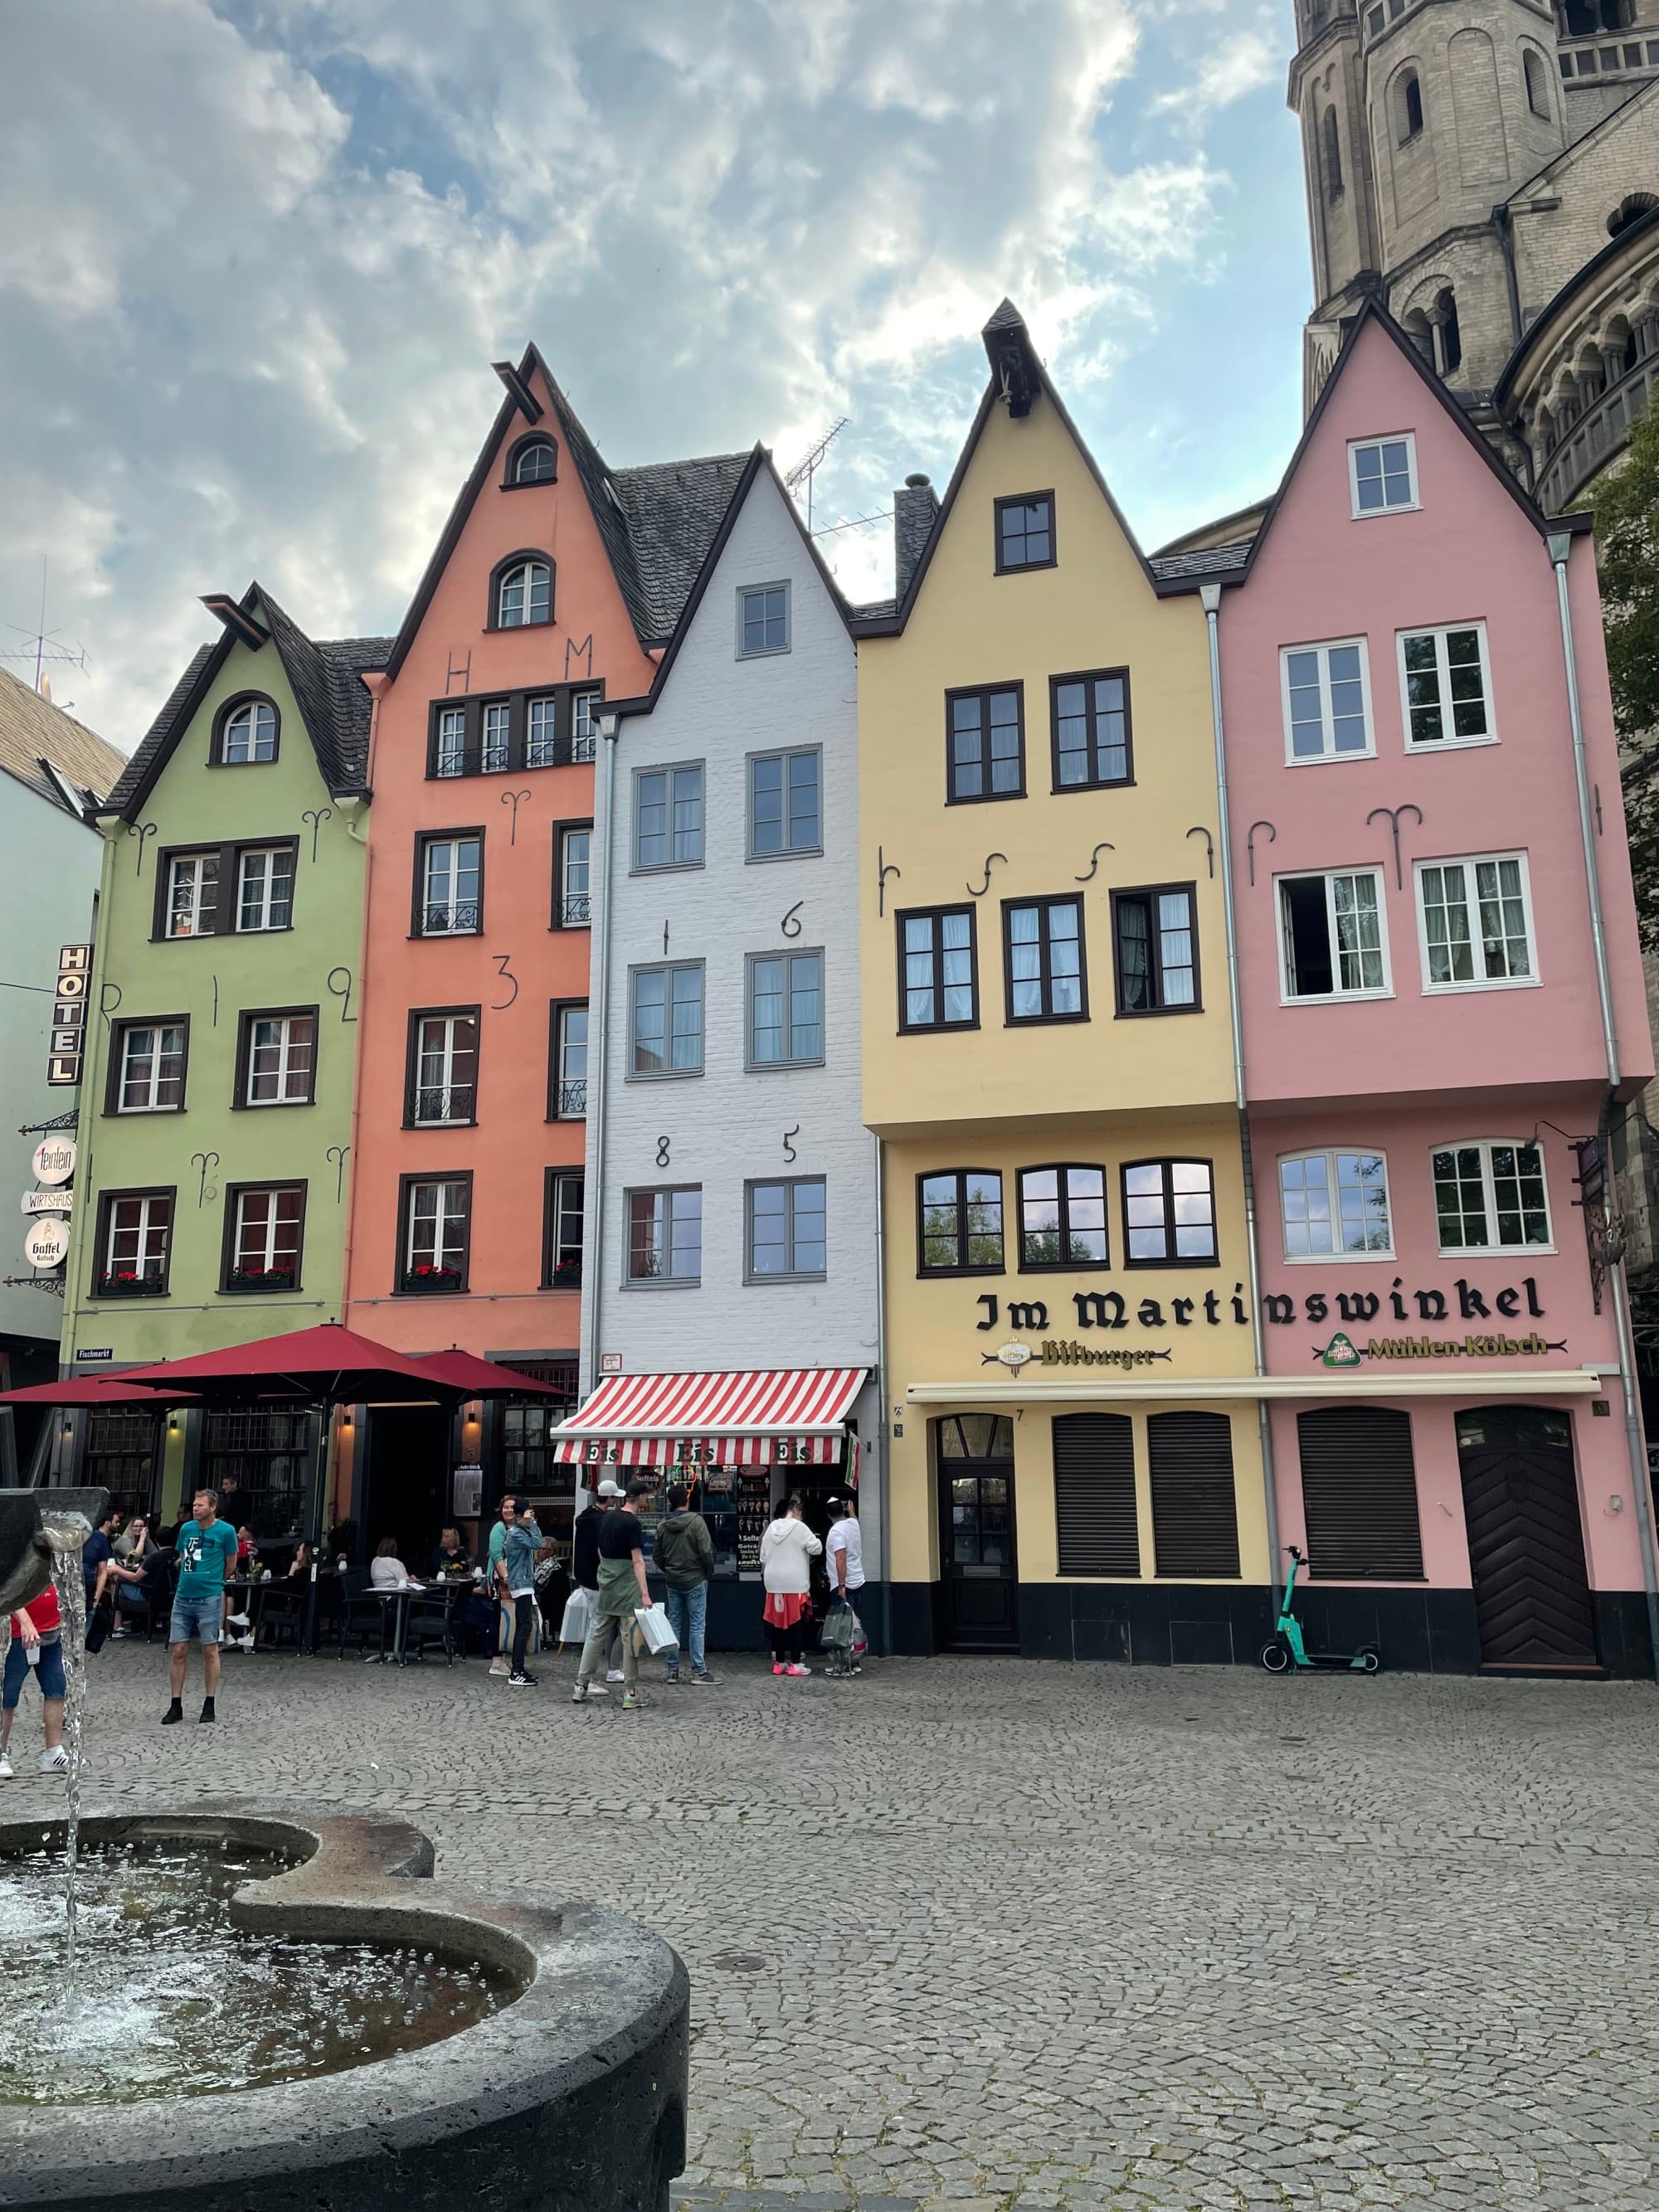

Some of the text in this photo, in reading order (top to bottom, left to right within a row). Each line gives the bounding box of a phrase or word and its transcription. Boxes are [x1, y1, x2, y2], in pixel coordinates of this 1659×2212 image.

[52, 948, 85, 1080] HOTEL
[655, 1135, 670, 1167] 8
[29, 1193, 72, 1208] WIRTSHAUS
[32, 1242, 61, 1255] Gaffel
[976, 1277, 1545, 1330] Im Martinswinkel
[79, 1349, 110, 1358] Fischmarkt
[1041, 1339, 1155, 1370] Bitburger
[1368, 1333, 1548, 1359] Mühlen Kölsch
[1016, 1408, 1024, 1422] 7
[584, 1442, 811, 1462] Eis Eis Eis
